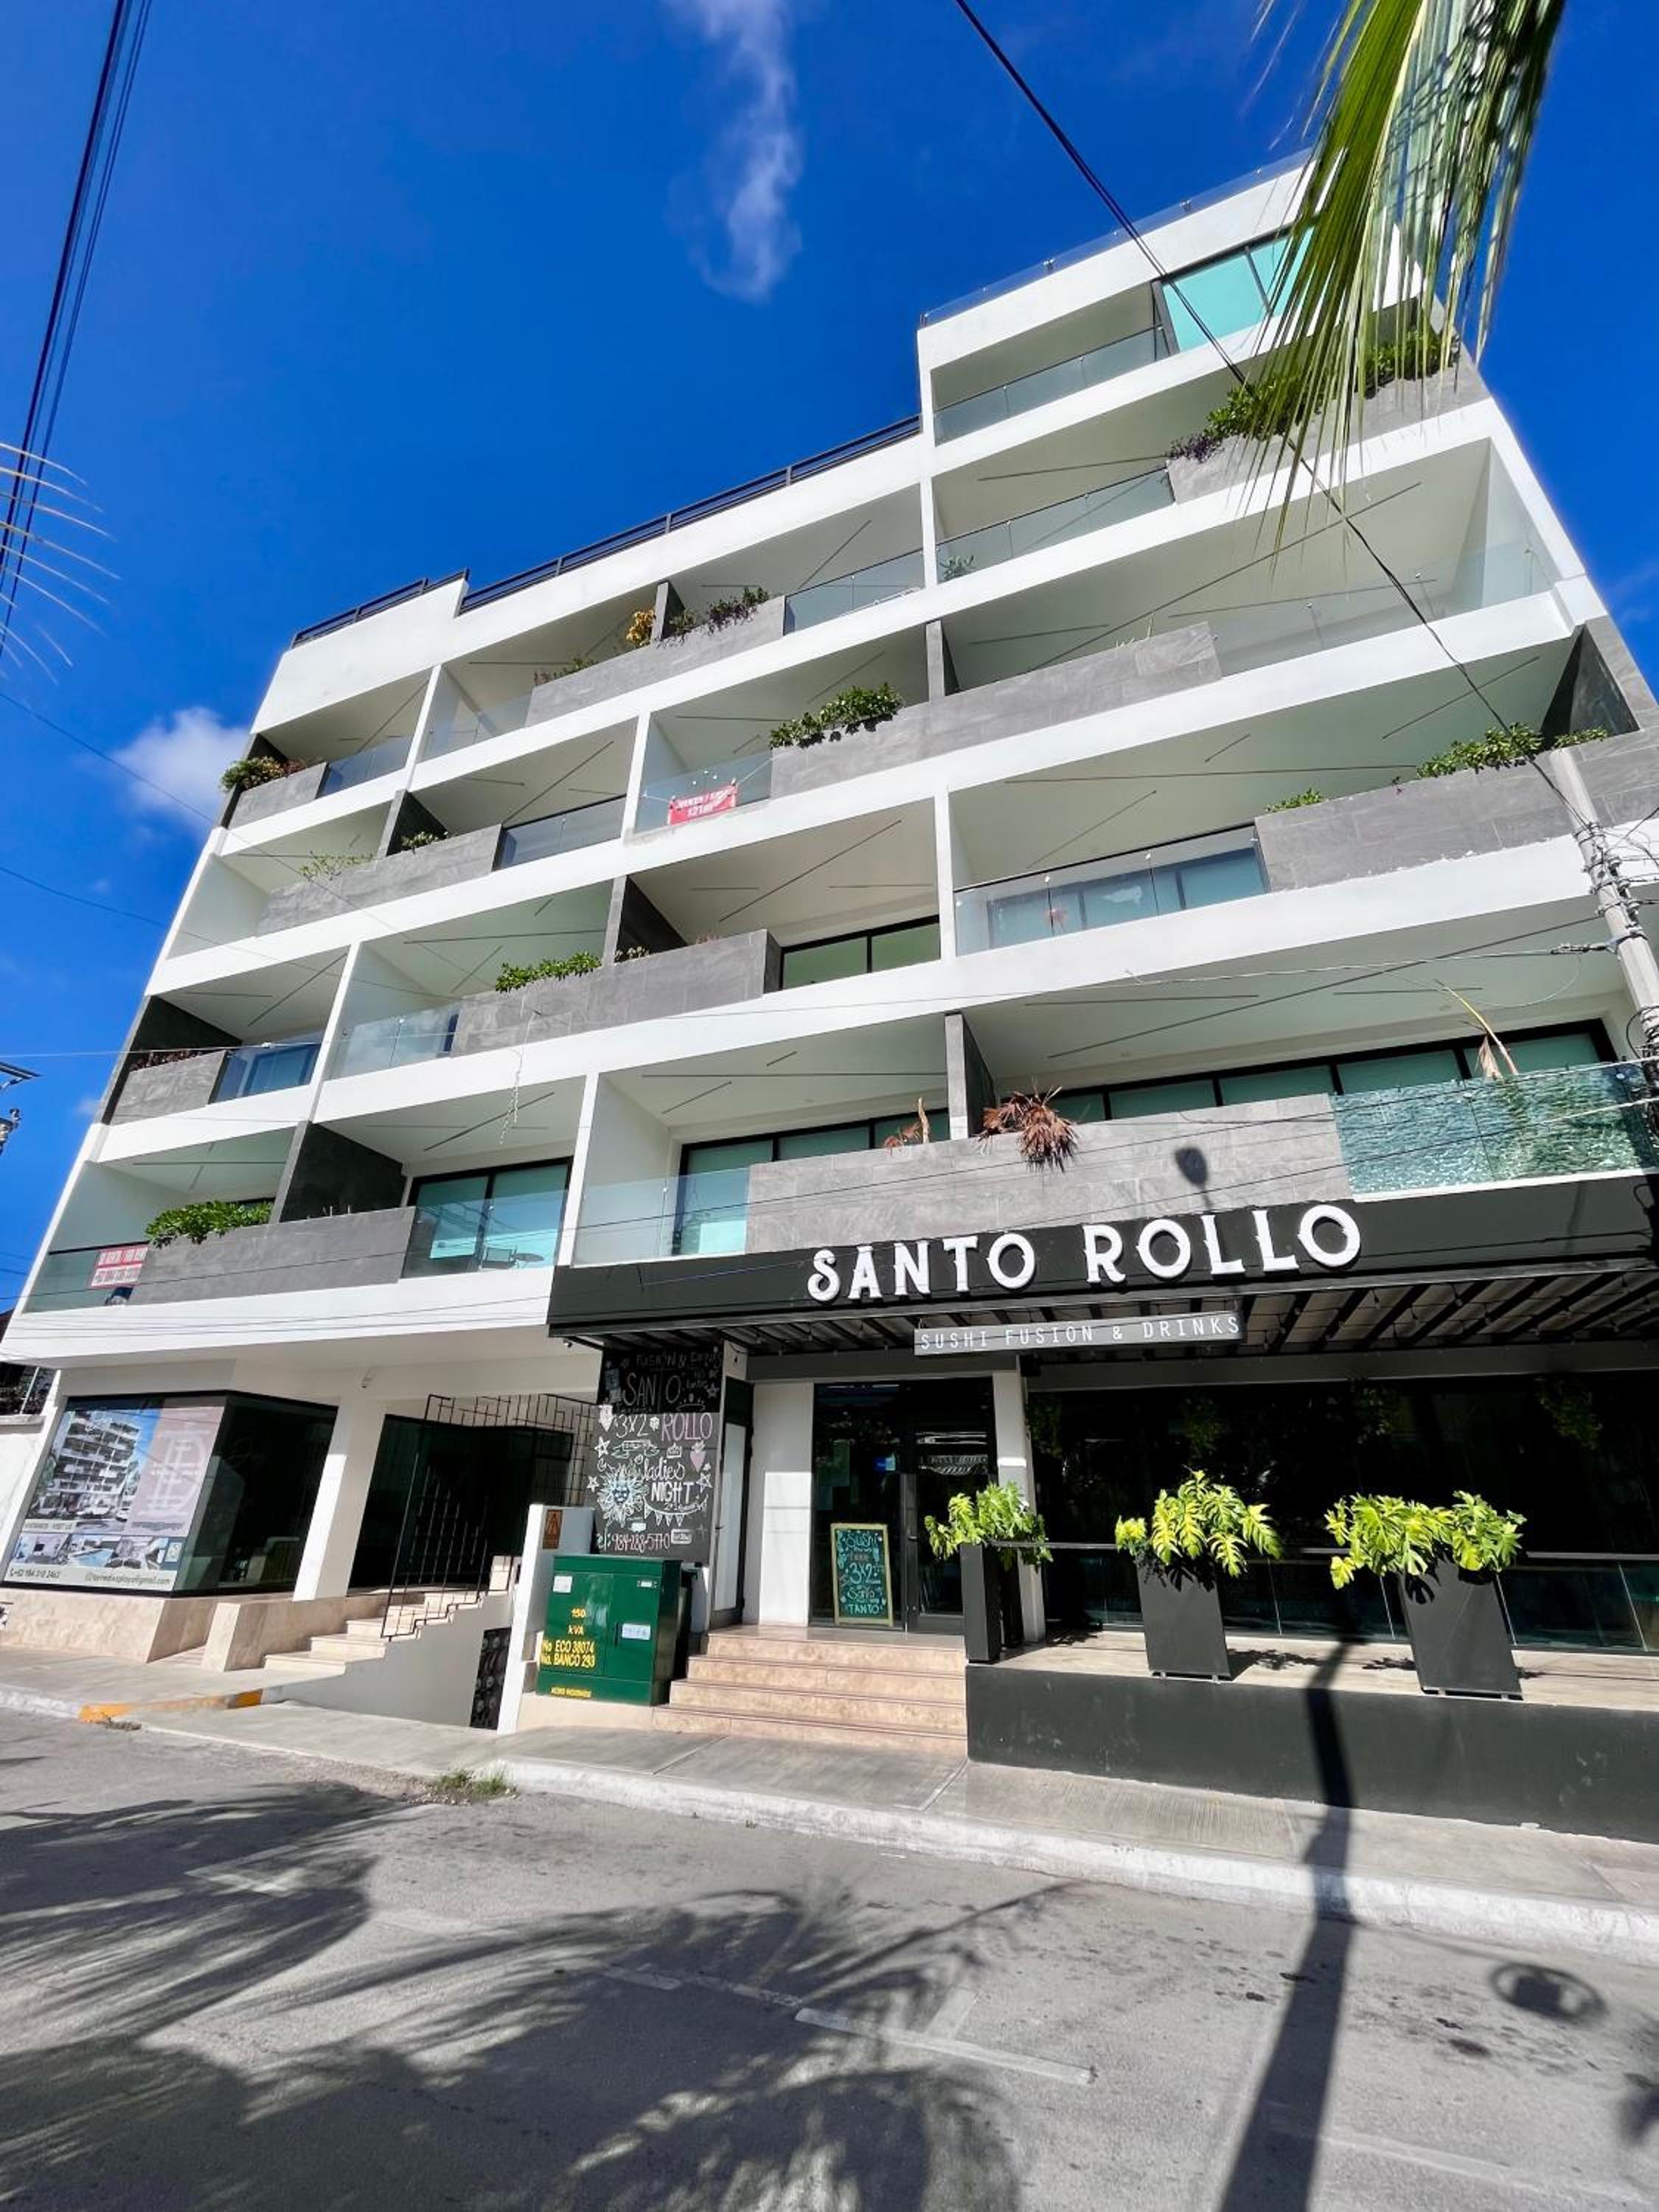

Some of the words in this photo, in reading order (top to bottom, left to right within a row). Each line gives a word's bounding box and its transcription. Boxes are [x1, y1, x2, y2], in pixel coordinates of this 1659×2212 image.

[806, 1231, 1037, 1303] SANTO
[1082, 1203, 1362, 1286] ROLLO
[919, 1330, 989, 1352] SUSHI
[1004, 1324, 1093, 1346] FUSION
[1111, 1324, 1124, 1340] &
[1143, 1314, 1241, 1339] DRINKS
[622, 1367, 682, 1411] SANTO
[661, 1413, 712, 1441] ROLLO
[650, 1481, 694, 1503] NIGHT
[571, 1608, 587, 1619] 150
[848, 1604, 880, 1615] TANTO
[555, 1639, 571, 1652] ECO
[553, 1652, 580, 1668] BANCO
